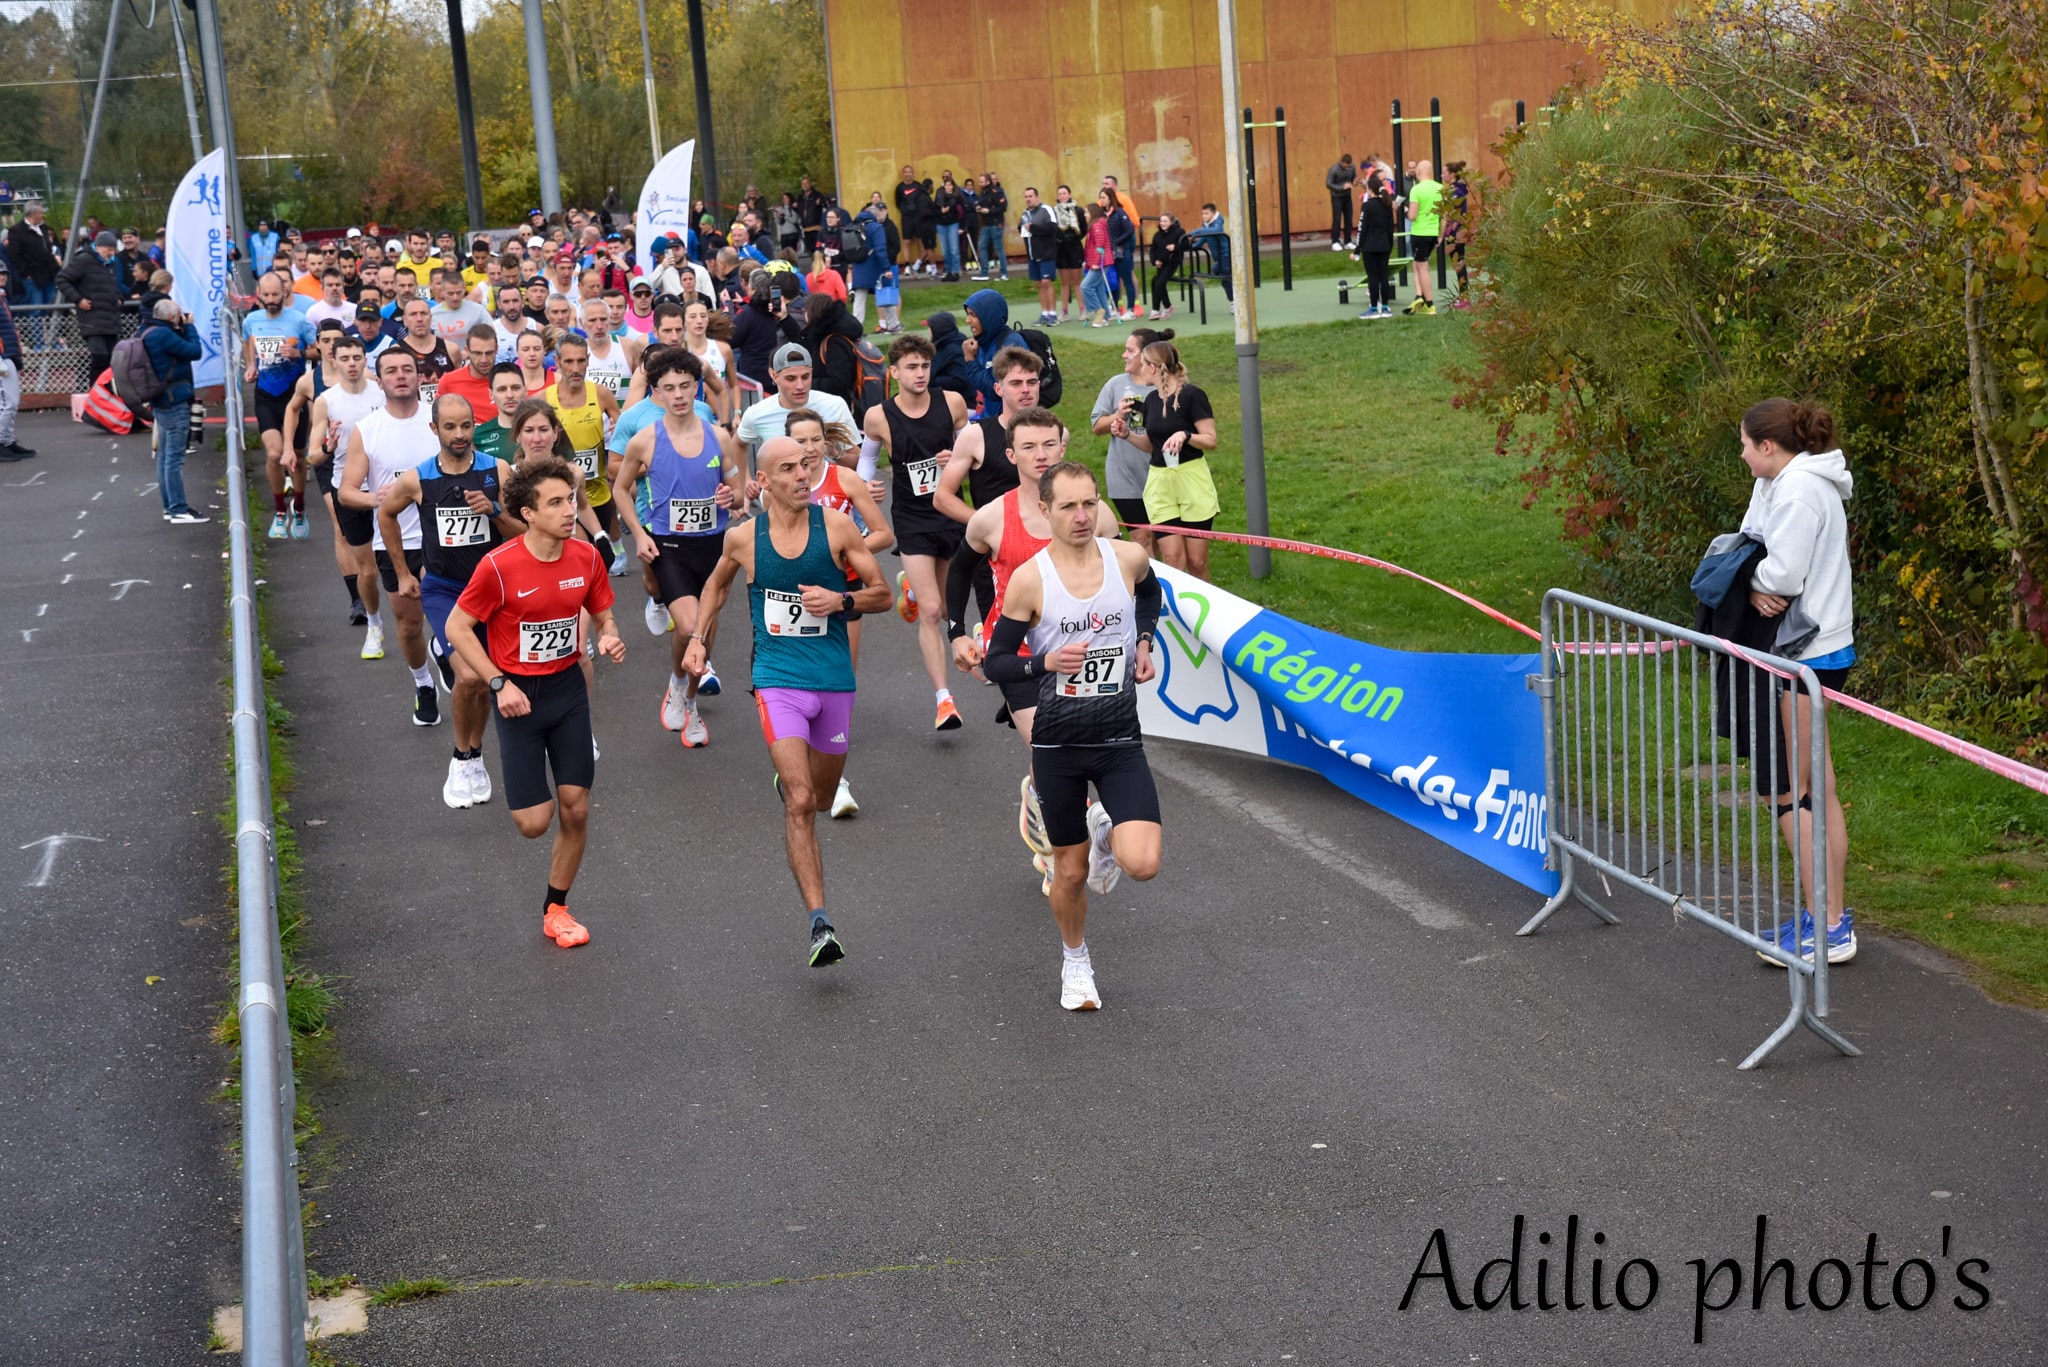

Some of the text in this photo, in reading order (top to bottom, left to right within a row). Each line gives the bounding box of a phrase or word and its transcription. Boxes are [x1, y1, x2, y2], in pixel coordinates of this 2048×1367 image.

[207, 228, 225, 302] Somme
[260, 342, 280, 353] 327
[593, 377, 617, 389] 266
[574, 457, 592, 471] 29
[917, 466, 937, 485] 27
[678, 507, 711, 523] 258
[445, 516, 481, 536] 277
[770, 592, 783, 601] LES
[789, 604, 802, 624] 9
[525, 618, 576, 631] LES 4 SAISONS
[530, 628, 572, 651] 229
[1086, 648, 1121, 659] SAISONS
[1235, 630, 1404, 722] Région
